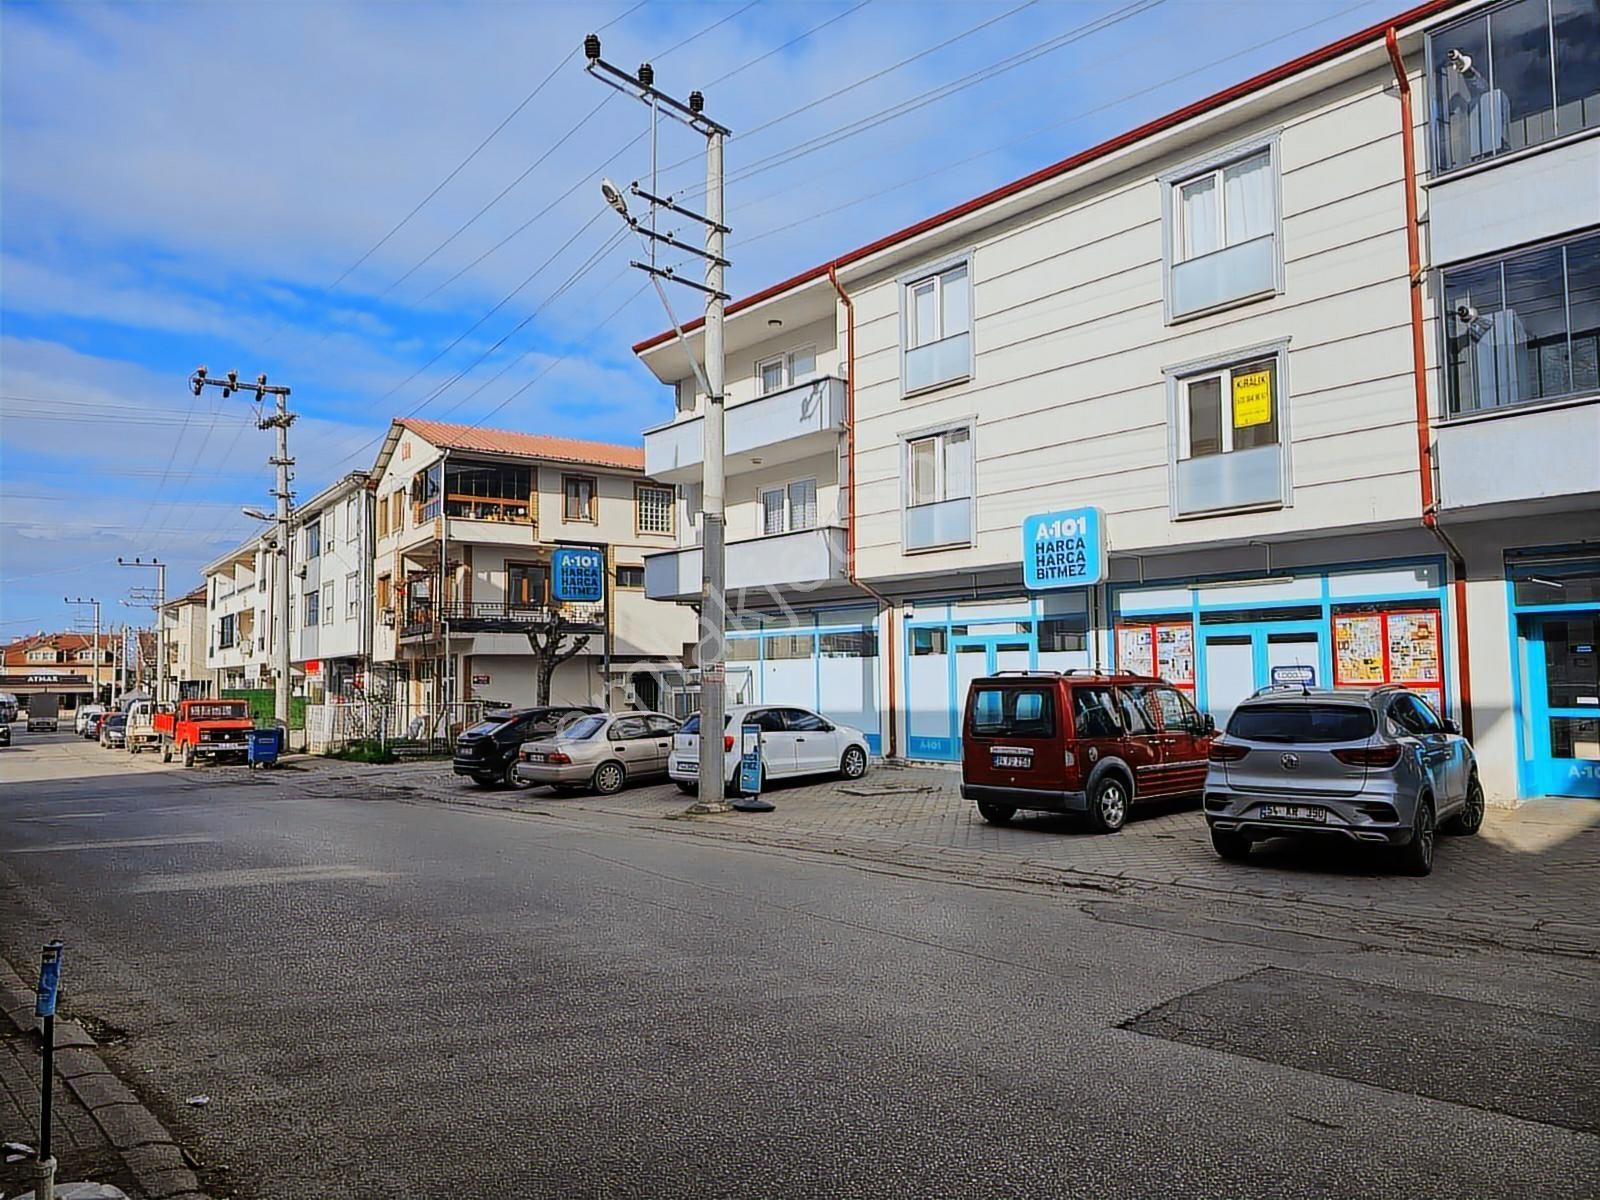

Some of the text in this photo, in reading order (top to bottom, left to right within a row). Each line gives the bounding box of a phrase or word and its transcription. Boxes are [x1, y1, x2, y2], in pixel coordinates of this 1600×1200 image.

[1035, 537, 1086, 555] HARCA
[1036, 550, 1086, 567] HARCA
[561, 567, 598, 577] HARCA
[561, 576, 598, 586] HARCA
